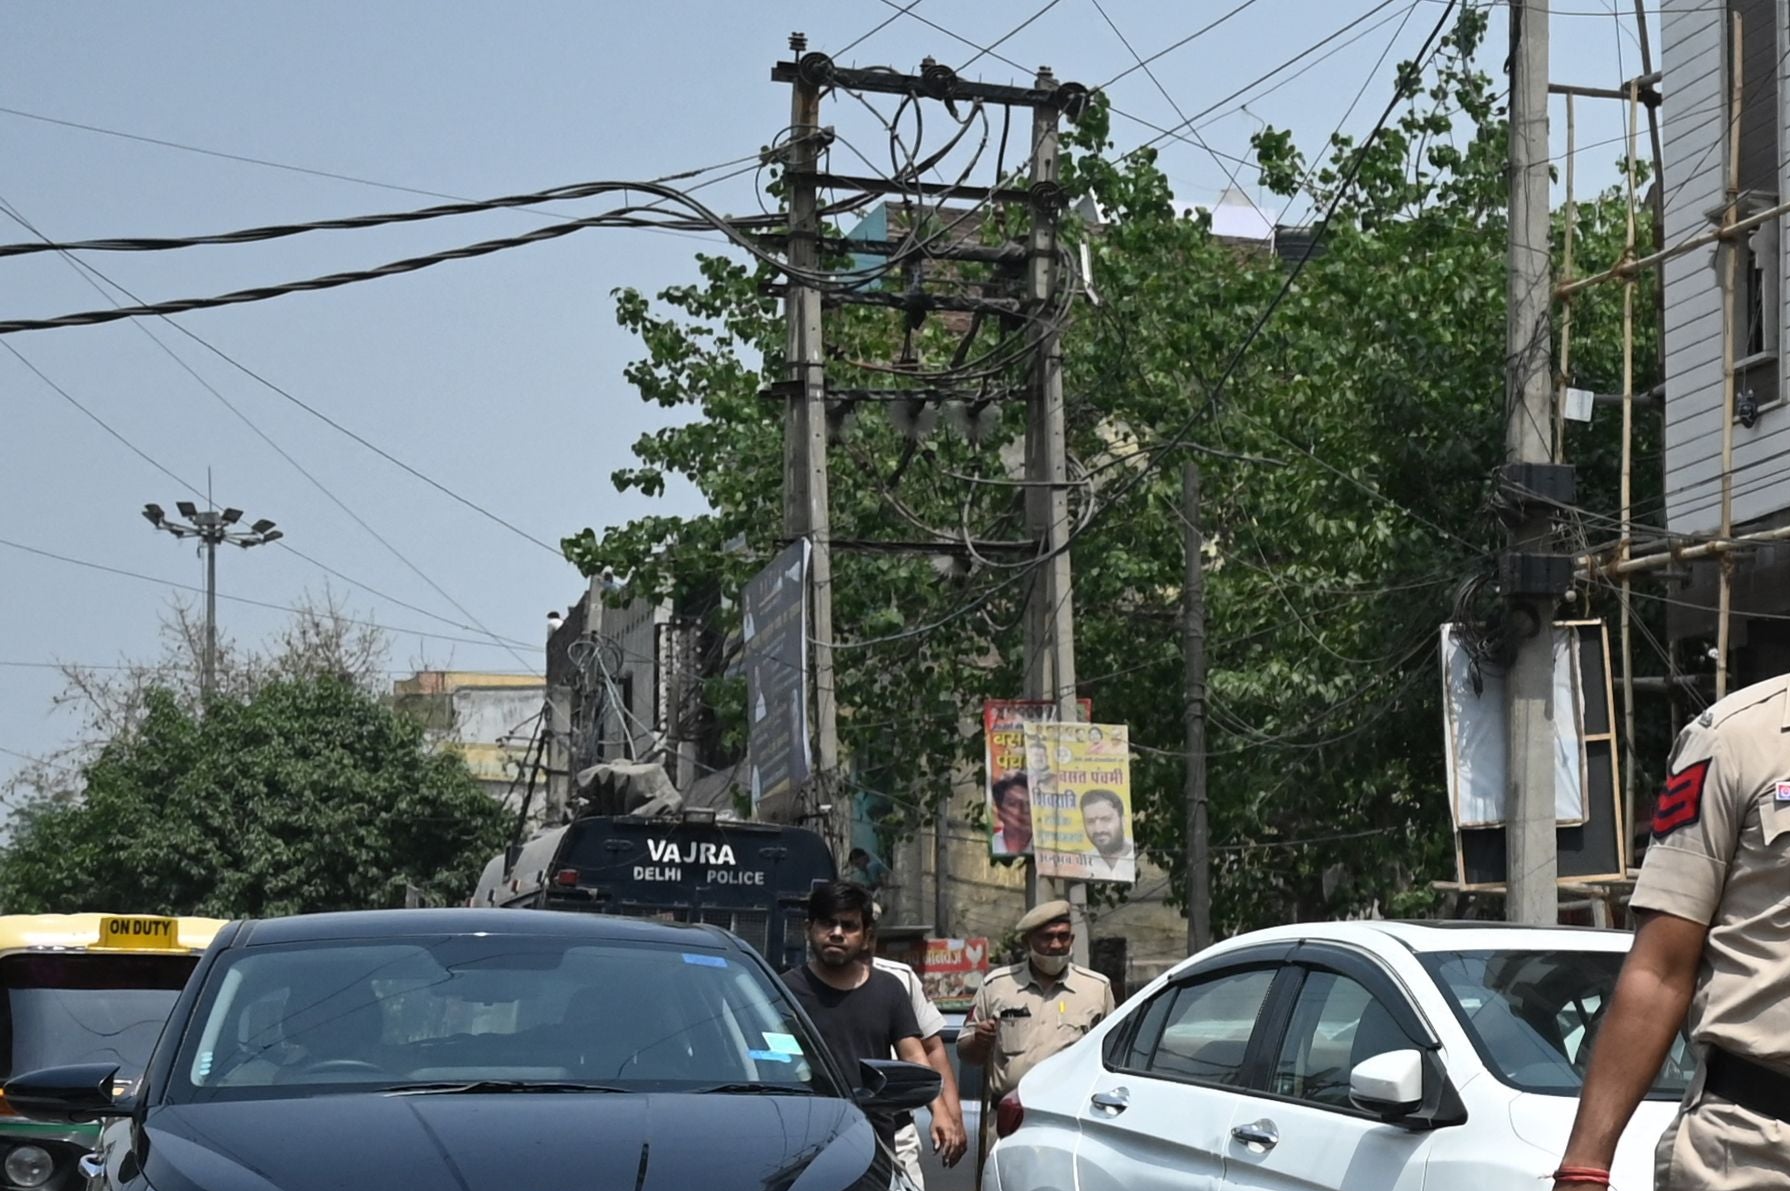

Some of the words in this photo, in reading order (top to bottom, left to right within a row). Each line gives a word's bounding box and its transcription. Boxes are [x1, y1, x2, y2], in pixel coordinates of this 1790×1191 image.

[647, 838, 736, 866] VAJRA
[633, 866, 682, 883] DELHI
[707, 869, 765, 886] POLICE
[110, 919, 130, 935] ON
[133, 920, 171, 936] DUTY
